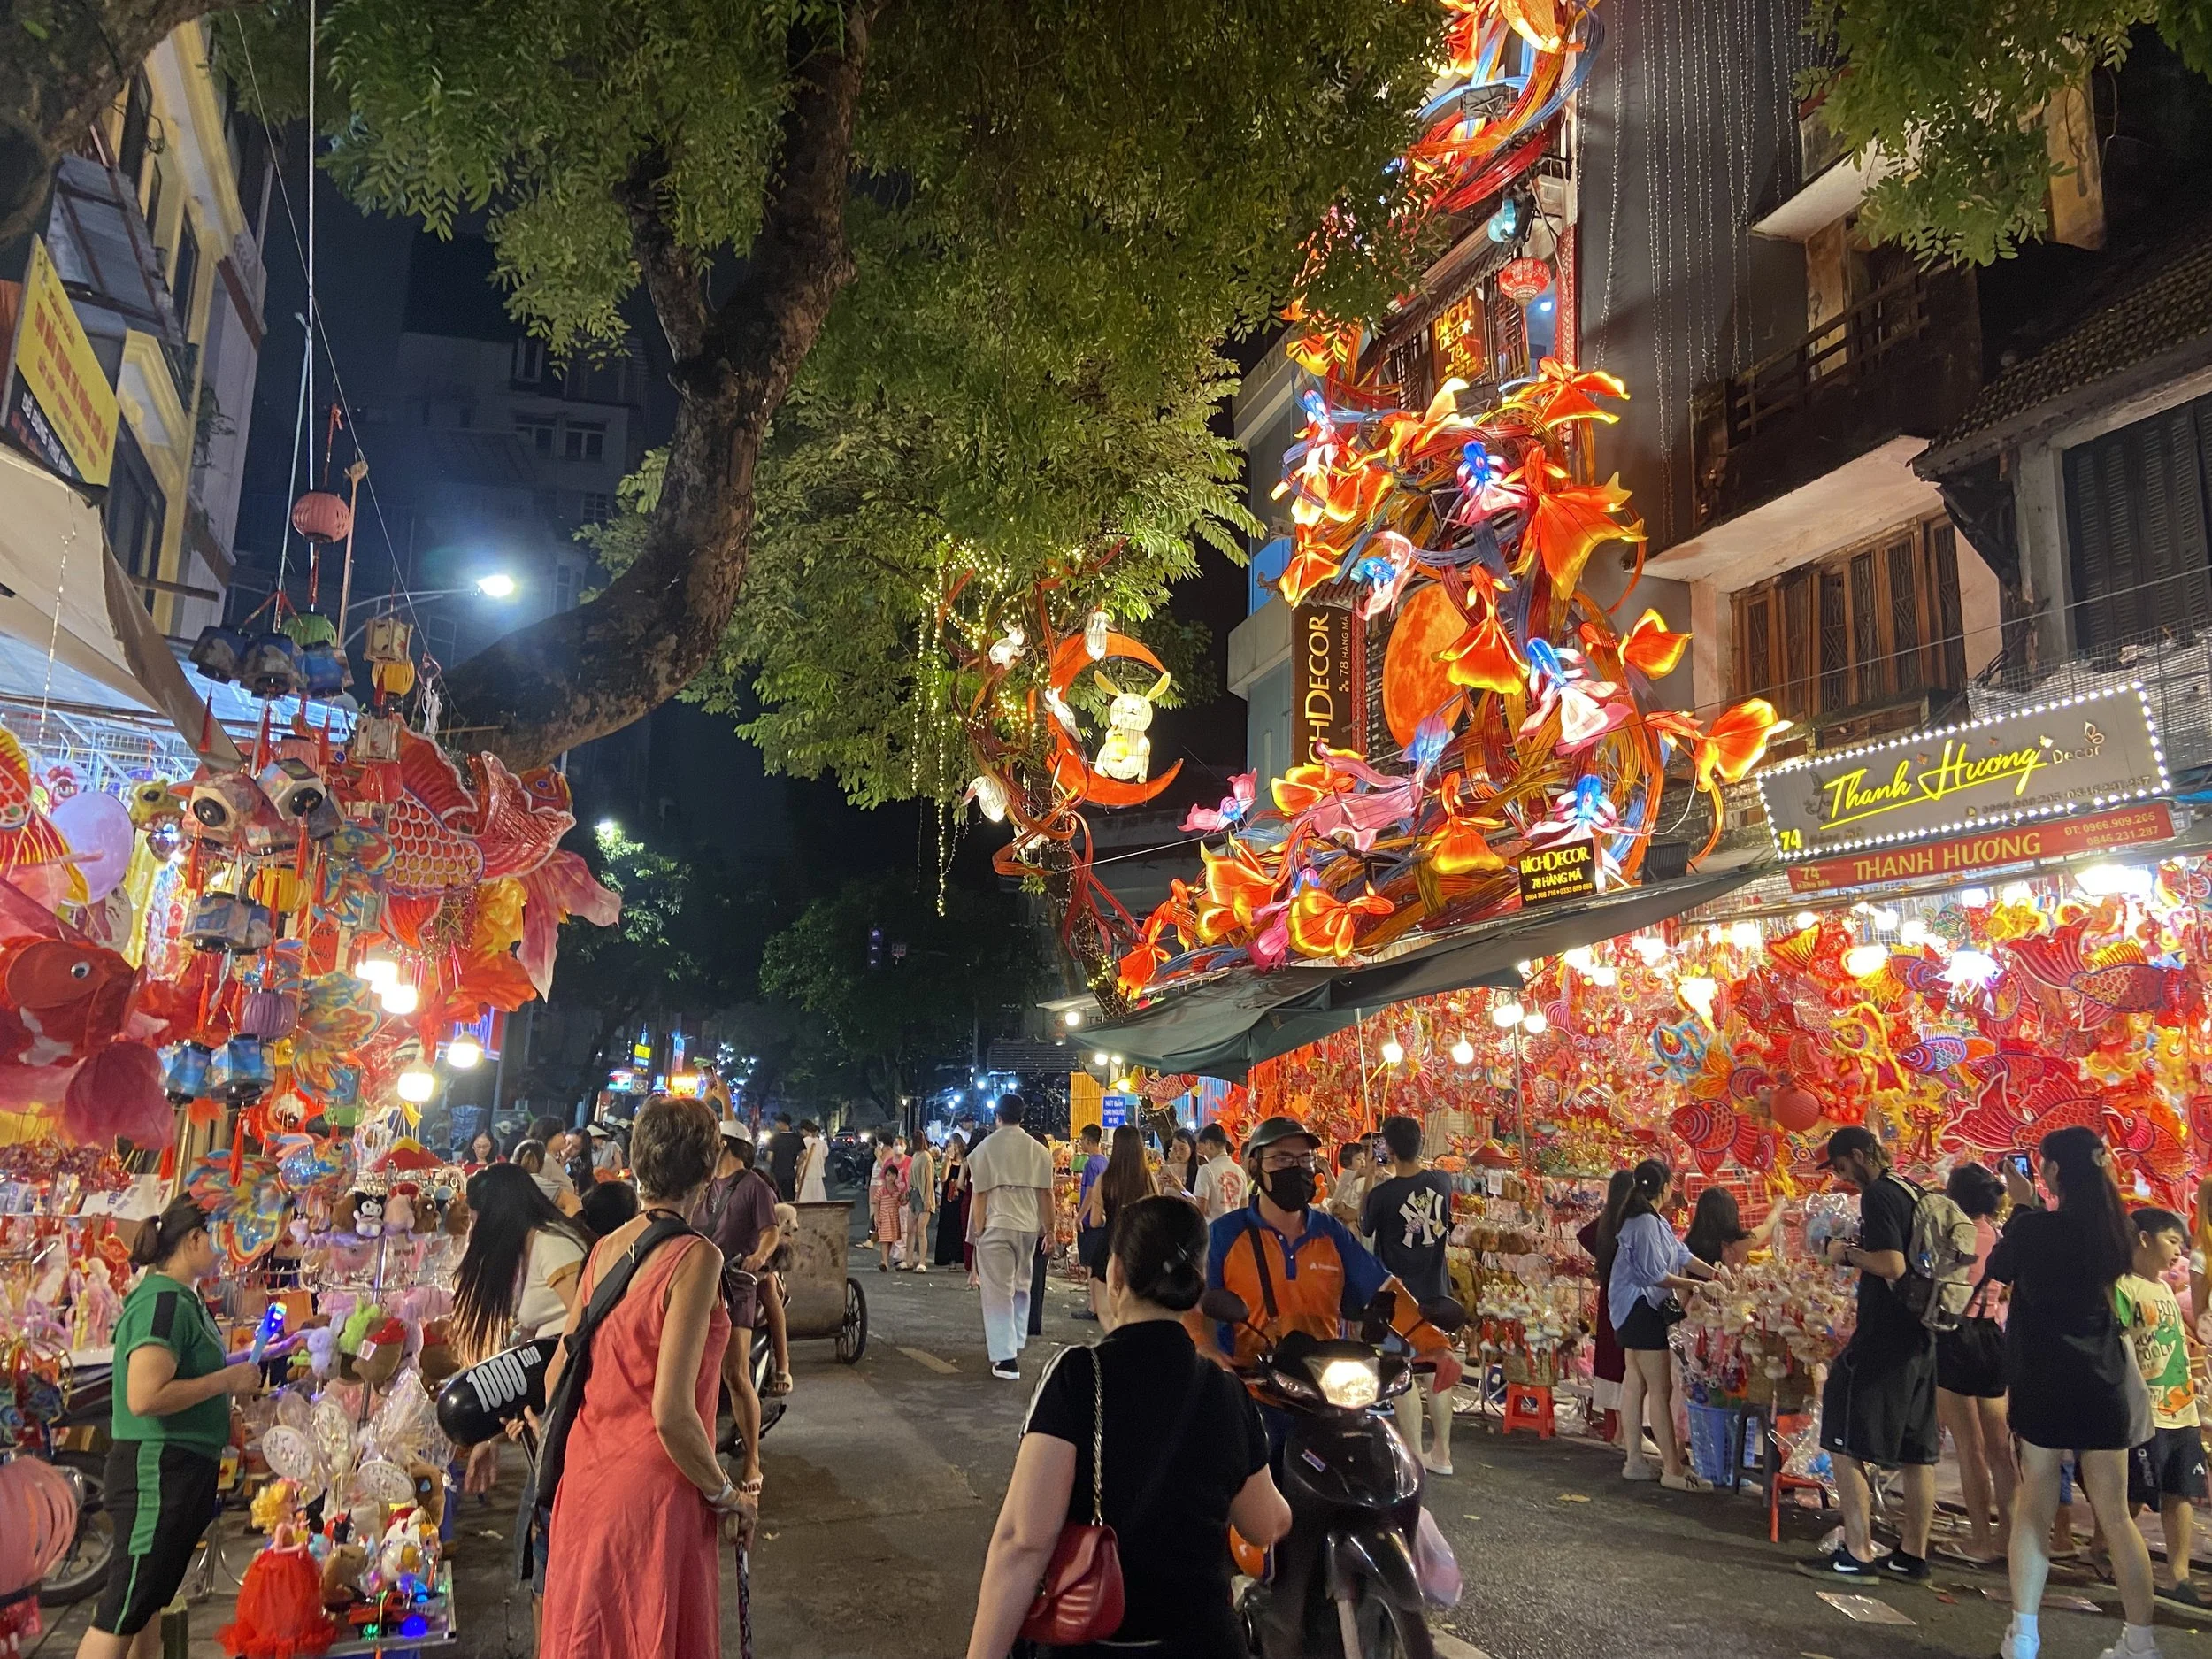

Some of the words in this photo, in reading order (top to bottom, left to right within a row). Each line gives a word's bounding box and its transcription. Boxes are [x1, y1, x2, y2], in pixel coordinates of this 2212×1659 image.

[1439, 319, 1474, 351] DECOR
[1448, 342, 1464, 363] 78
[1340, 632, 1349, 659] HÀNG
[1339, 661, 1349, 677] 78
[2052, 746, 2101, 764] Decor
[1824, 759, 1912, 818] Thanh
[2082, 811, 2156, 833] 0966.909.205
[1779, 828, 1802, 851] 74
[1853, 848, 1933, 881] THANH
[1943, 832, 2041, 870] HƯƠNG
[1541, 872, 1568, 887] HÀNG
[1801, 867, 1820, 881] 74
[1399, 1187, 1447, 1248] NY
[465, 1353, 528, 1413] 1000
[517, 1345, 541, 1368] ton
